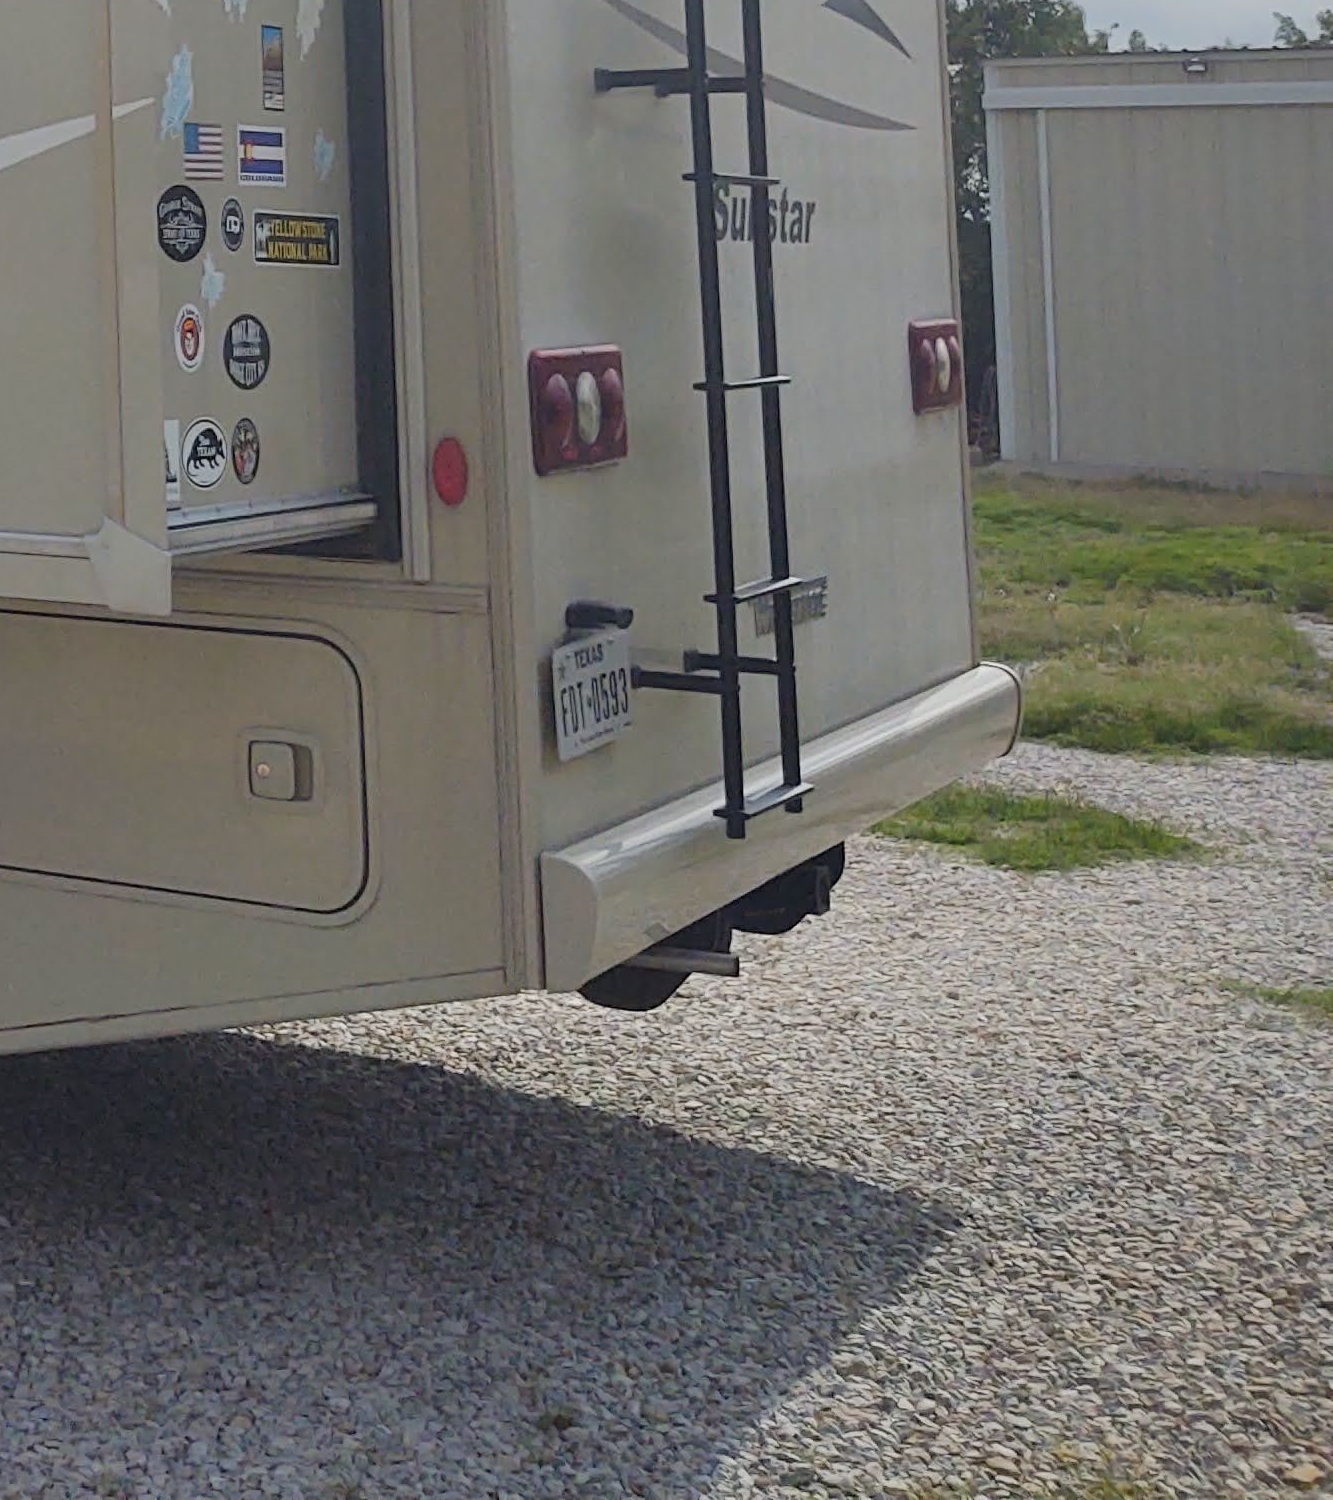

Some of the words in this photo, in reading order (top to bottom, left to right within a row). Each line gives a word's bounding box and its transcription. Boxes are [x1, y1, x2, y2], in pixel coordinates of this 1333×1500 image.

[713, 179, 816, 244] Sustar
[268, 218, 326, 238] YELLOWSTONE
[268, 241, 307, 261] NATIONAL
[574, 643, 605, 669] TEXAS
